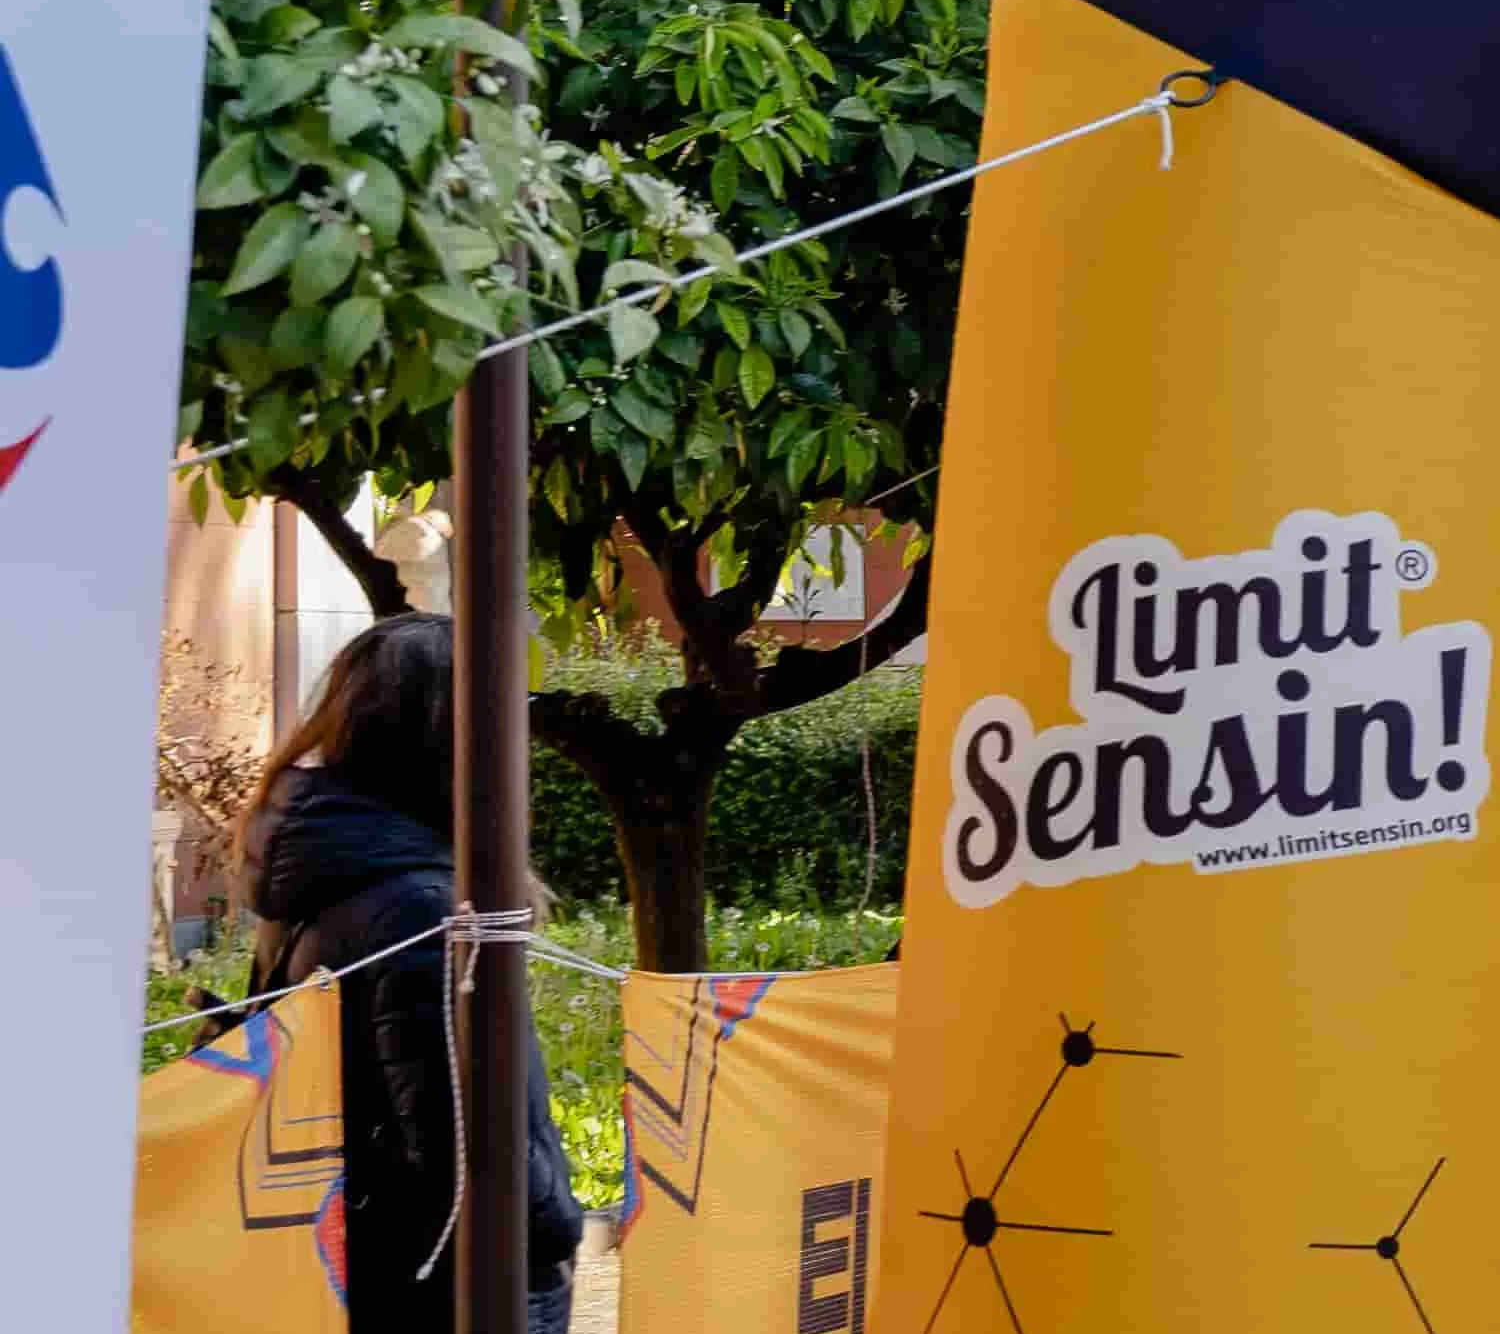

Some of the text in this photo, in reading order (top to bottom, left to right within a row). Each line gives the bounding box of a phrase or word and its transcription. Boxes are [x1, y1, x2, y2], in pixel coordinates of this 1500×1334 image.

[1072, 536, 1382, 714] Limit
[956, 647, 1467, 883] Sensin!
[1197, 809, 1472, 869] www.limitsensin.org
